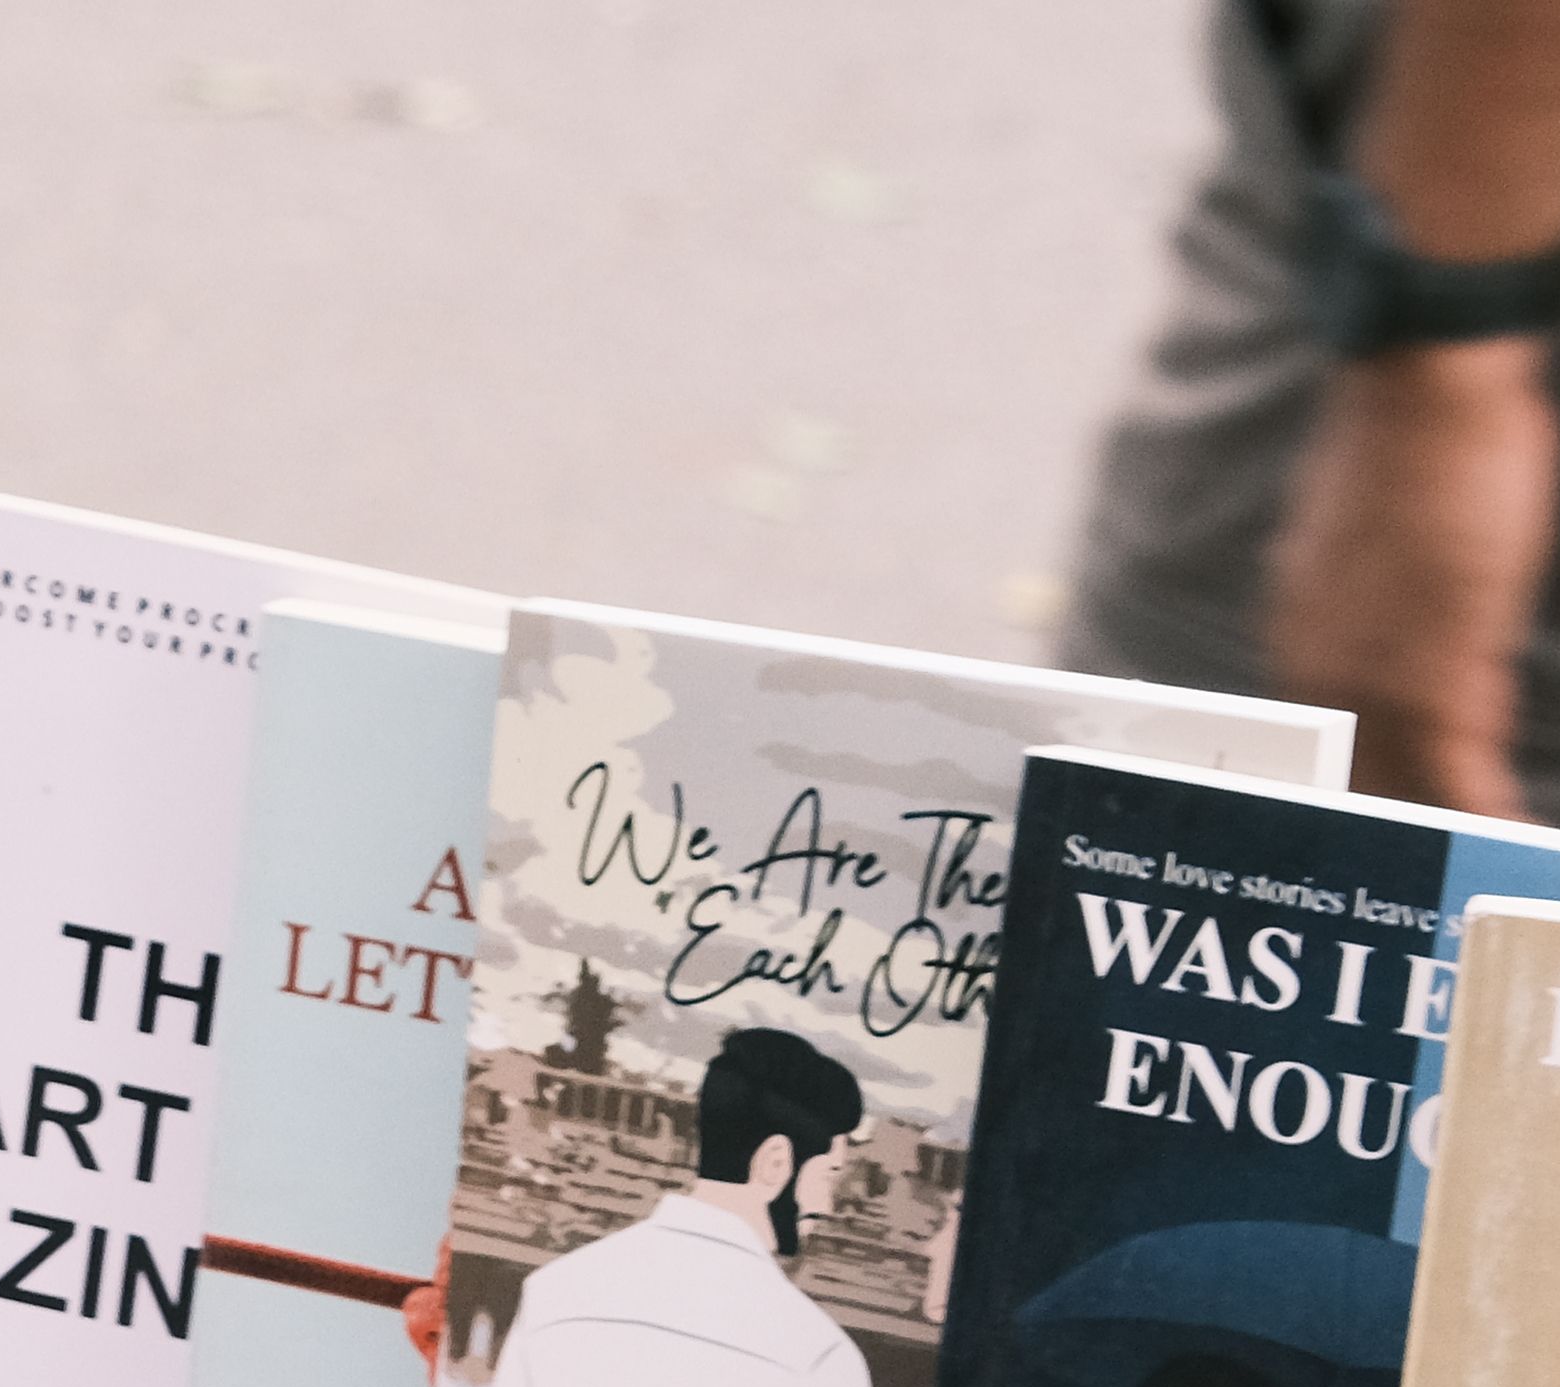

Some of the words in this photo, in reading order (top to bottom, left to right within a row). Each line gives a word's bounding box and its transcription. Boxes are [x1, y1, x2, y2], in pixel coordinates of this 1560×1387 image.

[93, 619, 184, 657] YOUR
[566, 760, 719, 887] We
[1062, 833, 1156, 881] Some
[1162, 850, 1234, 895] love
[1239, 876, 1347, 917] stories
[1353, 887, 1438, 934] leave
[1076, 892, 1303, 1012] WAS
[1325, 940, 1376, 1026] I
